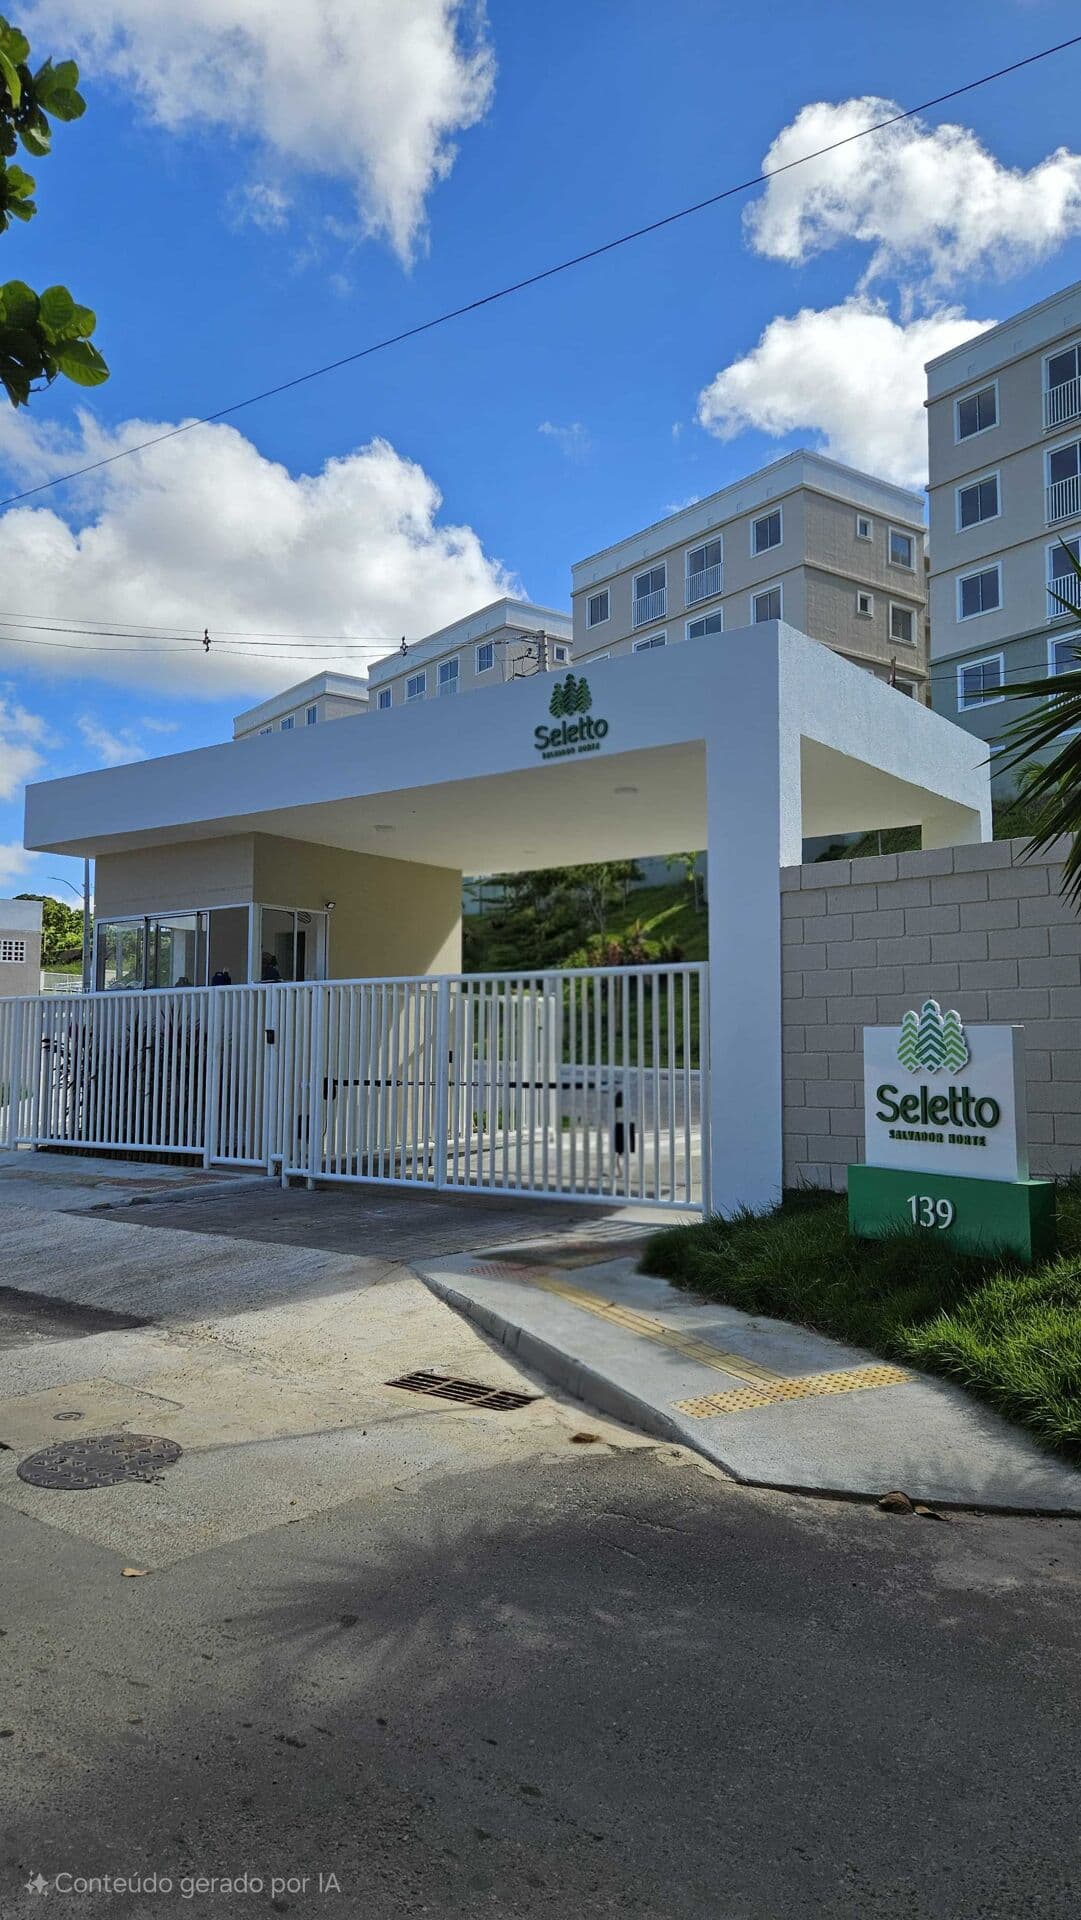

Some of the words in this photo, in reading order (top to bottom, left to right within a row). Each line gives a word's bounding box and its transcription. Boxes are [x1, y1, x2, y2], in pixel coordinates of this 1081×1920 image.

[534, 715, 608, 750] Seletto
[876, 1084, 1000, 1128] Seletto
[889, 1129, 943, 1143] SALVADOR
[907, 1193, 954, 1230] 139
